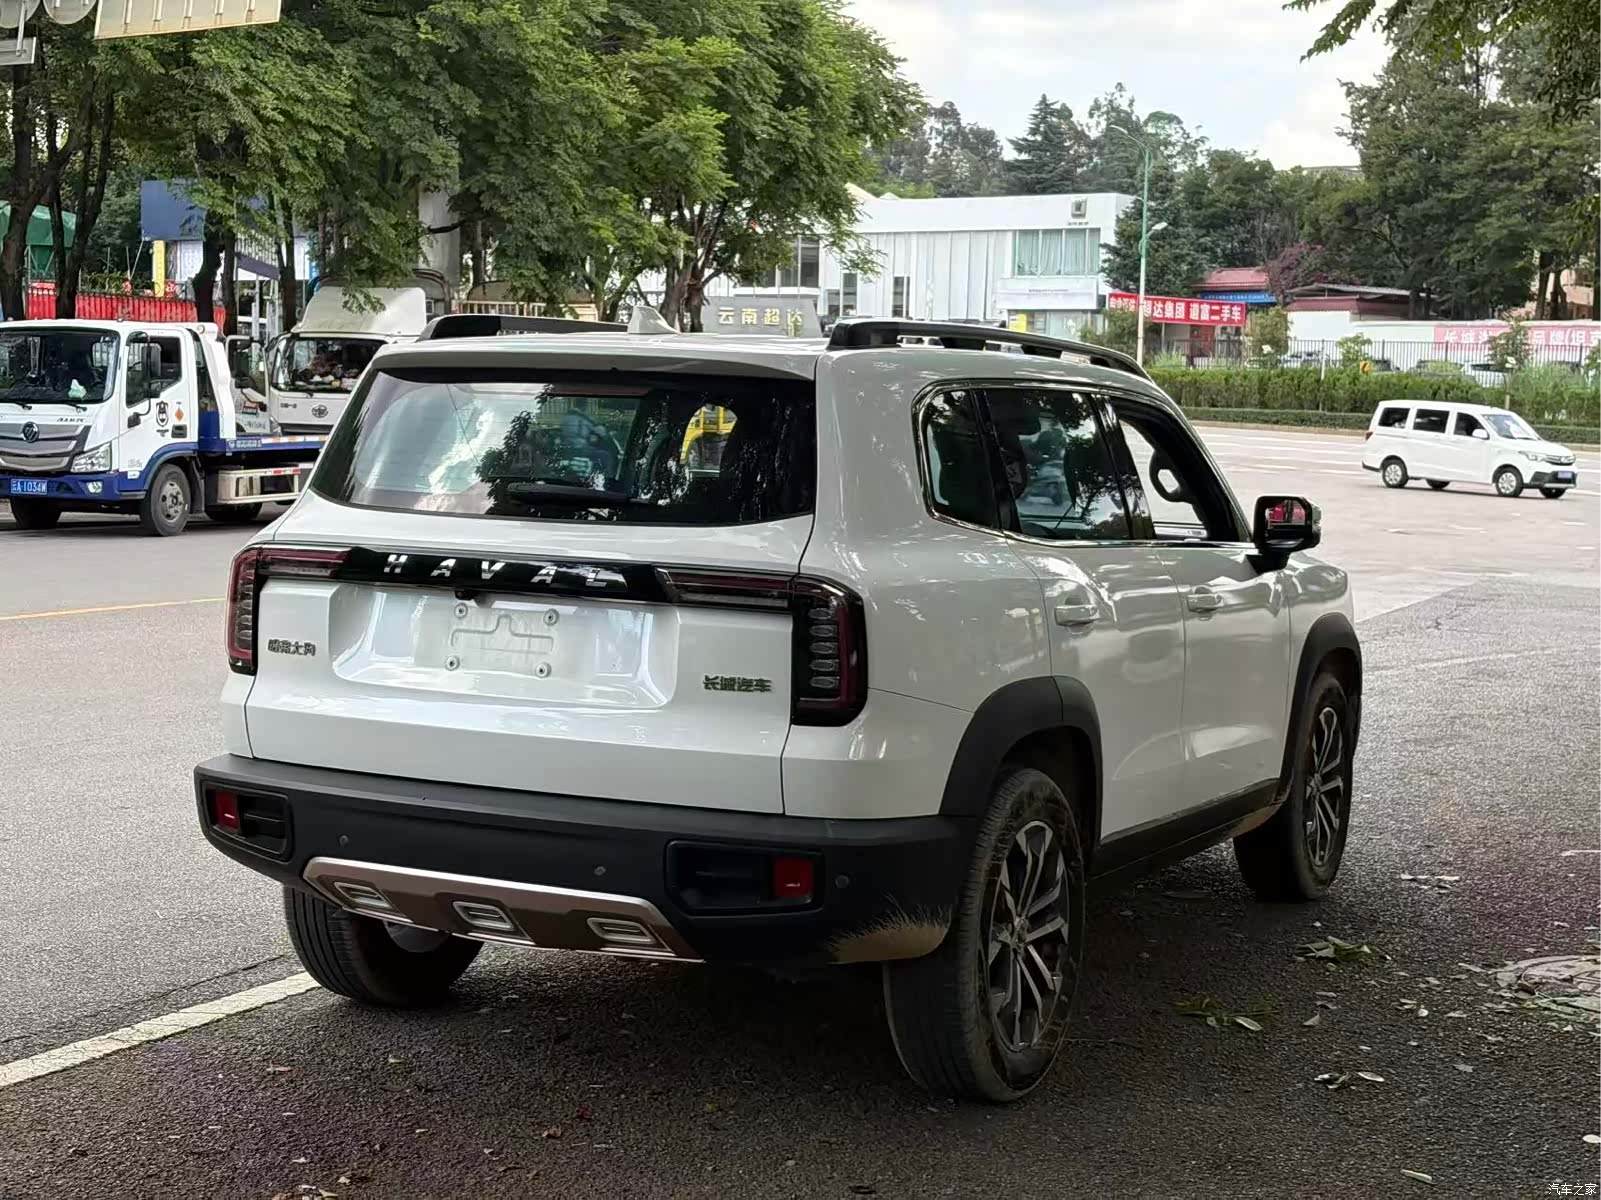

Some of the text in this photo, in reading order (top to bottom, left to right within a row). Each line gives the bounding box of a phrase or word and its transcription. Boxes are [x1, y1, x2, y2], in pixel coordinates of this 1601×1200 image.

[718, 306, 803, 327] 云南超达
[1189, 303, 1242, 323] 道富二手车
[383, 554, 607, 588] HAVAL
[703, 674, 772, 692] 长城汽车
